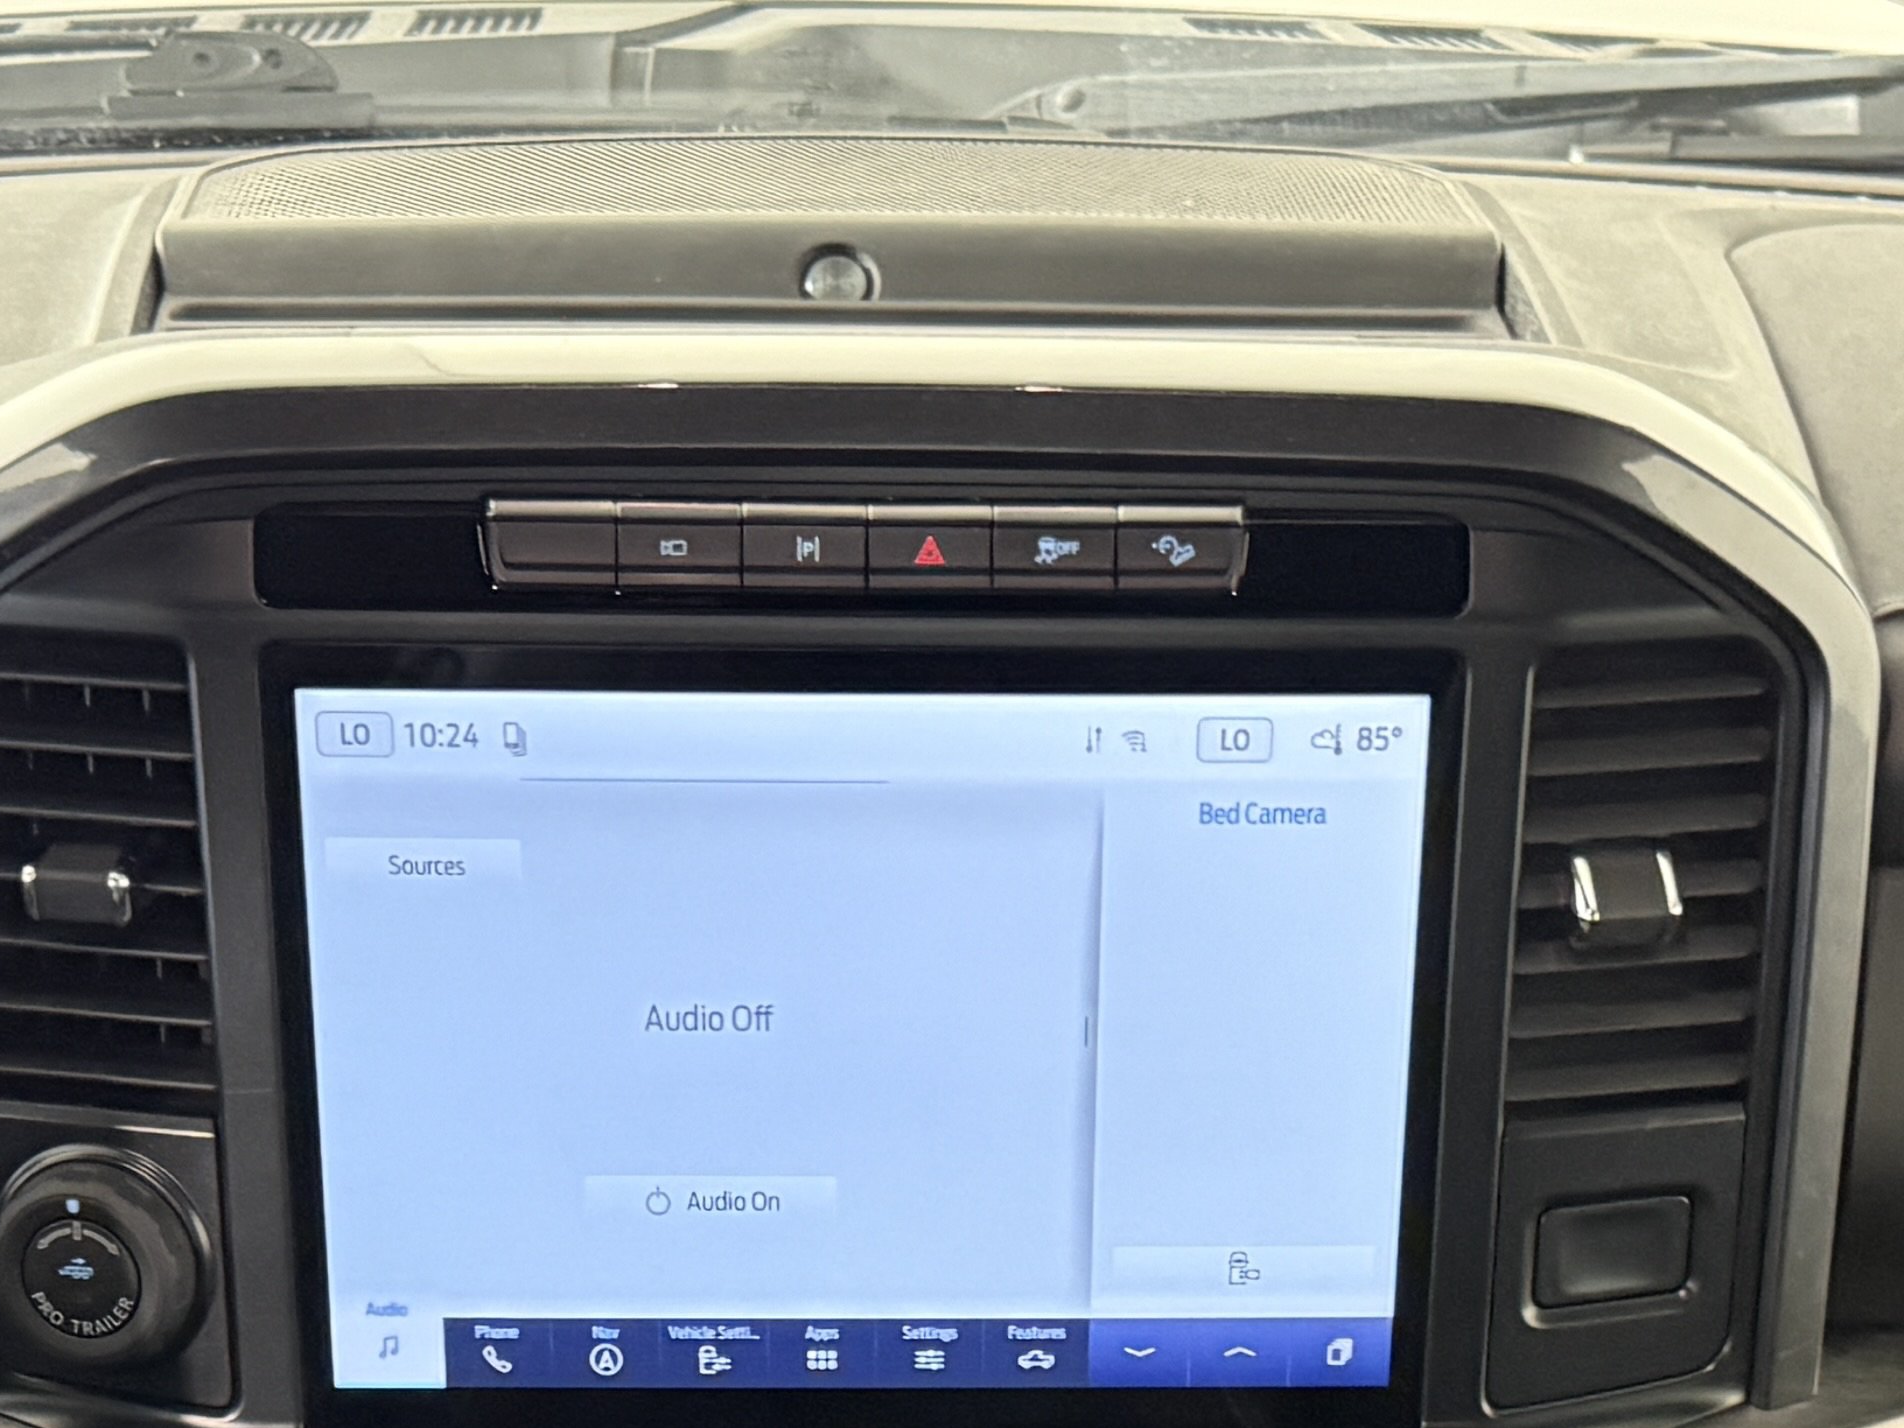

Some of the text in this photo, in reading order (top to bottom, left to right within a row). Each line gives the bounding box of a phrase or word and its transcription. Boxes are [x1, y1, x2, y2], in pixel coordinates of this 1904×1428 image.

[1056, 539, 1081, 555] OFF
[339, 721, 479, 749] LO 10:24
[1220, 726, 1404, 752] LO 85°
[1198, 802, 1328, 825] Bed Camera
[388, 855, 466, 877] Sources
[644, 1003, 774, 1033] Audio Off
[687, 1190, 781, 1213] Audio On
[31, 1291, 135, 1336] PRO TRAILER
[365, 1301, 408, 1318] Audio
[474, 1325, 520, 1341] Phone
[591, 1325, 621, 1341] Nav
[667, 1325, 716, 1341] Vehicle
[804, 1325, 841, 1344] Apps
[901, 1325, 959, 1343] Settings
[1006, 1325, 1067, 1341] Features
